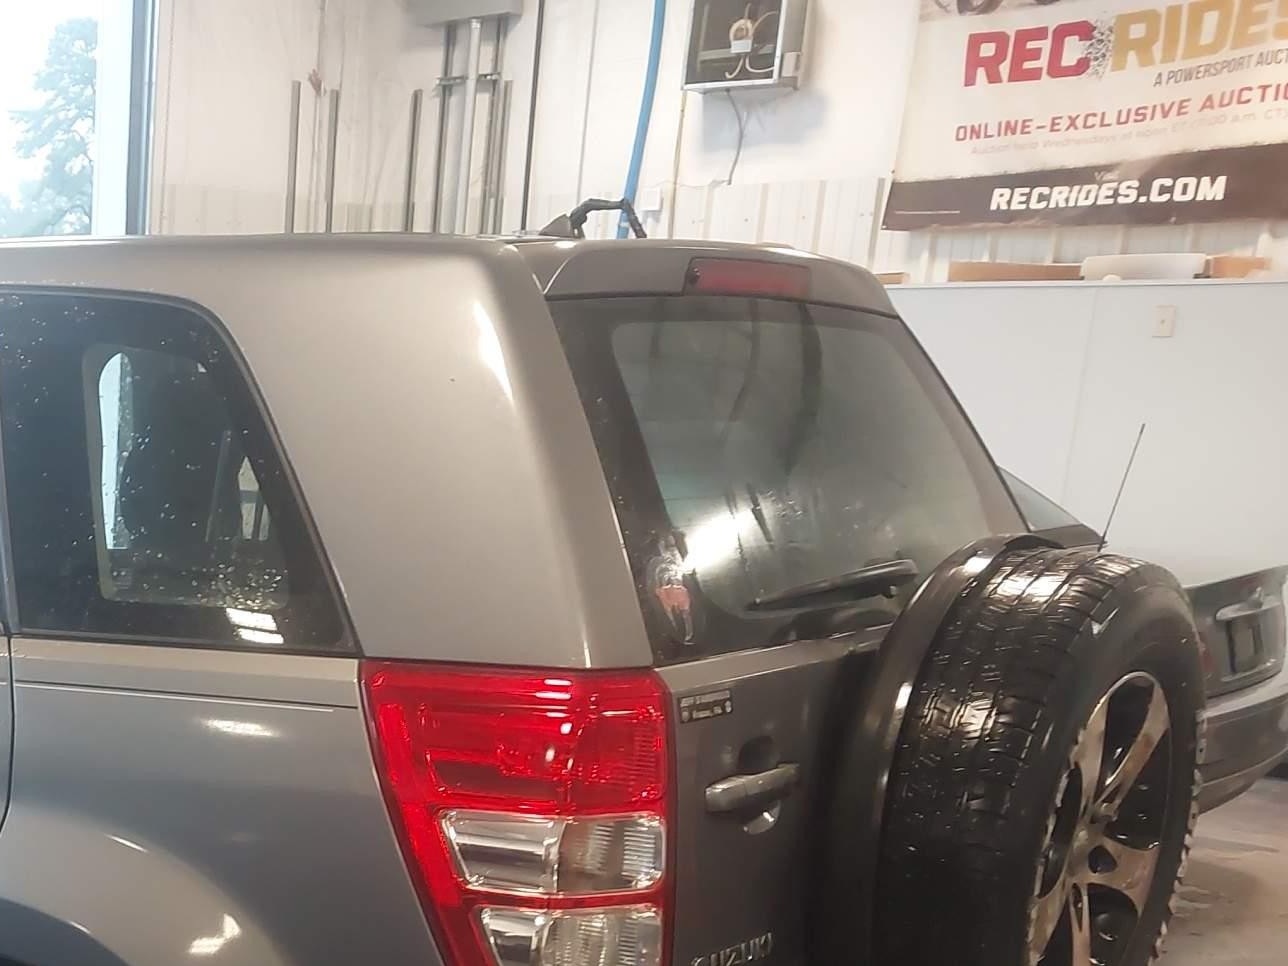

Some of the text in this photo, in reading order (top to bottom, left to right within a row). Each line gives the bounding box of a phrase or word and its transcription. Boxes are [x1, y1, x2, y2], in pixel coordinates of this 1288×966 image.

[964, 20, 1097, 87] REC
[1153, 71, 1162, 87] A
[1165, 54, 1254, 85] POWERSPORT
[955, 98, 1193, 142] ONLINE-EXCLUSIVE
[990, 175, 1227, 210] RECRIDES.COM
